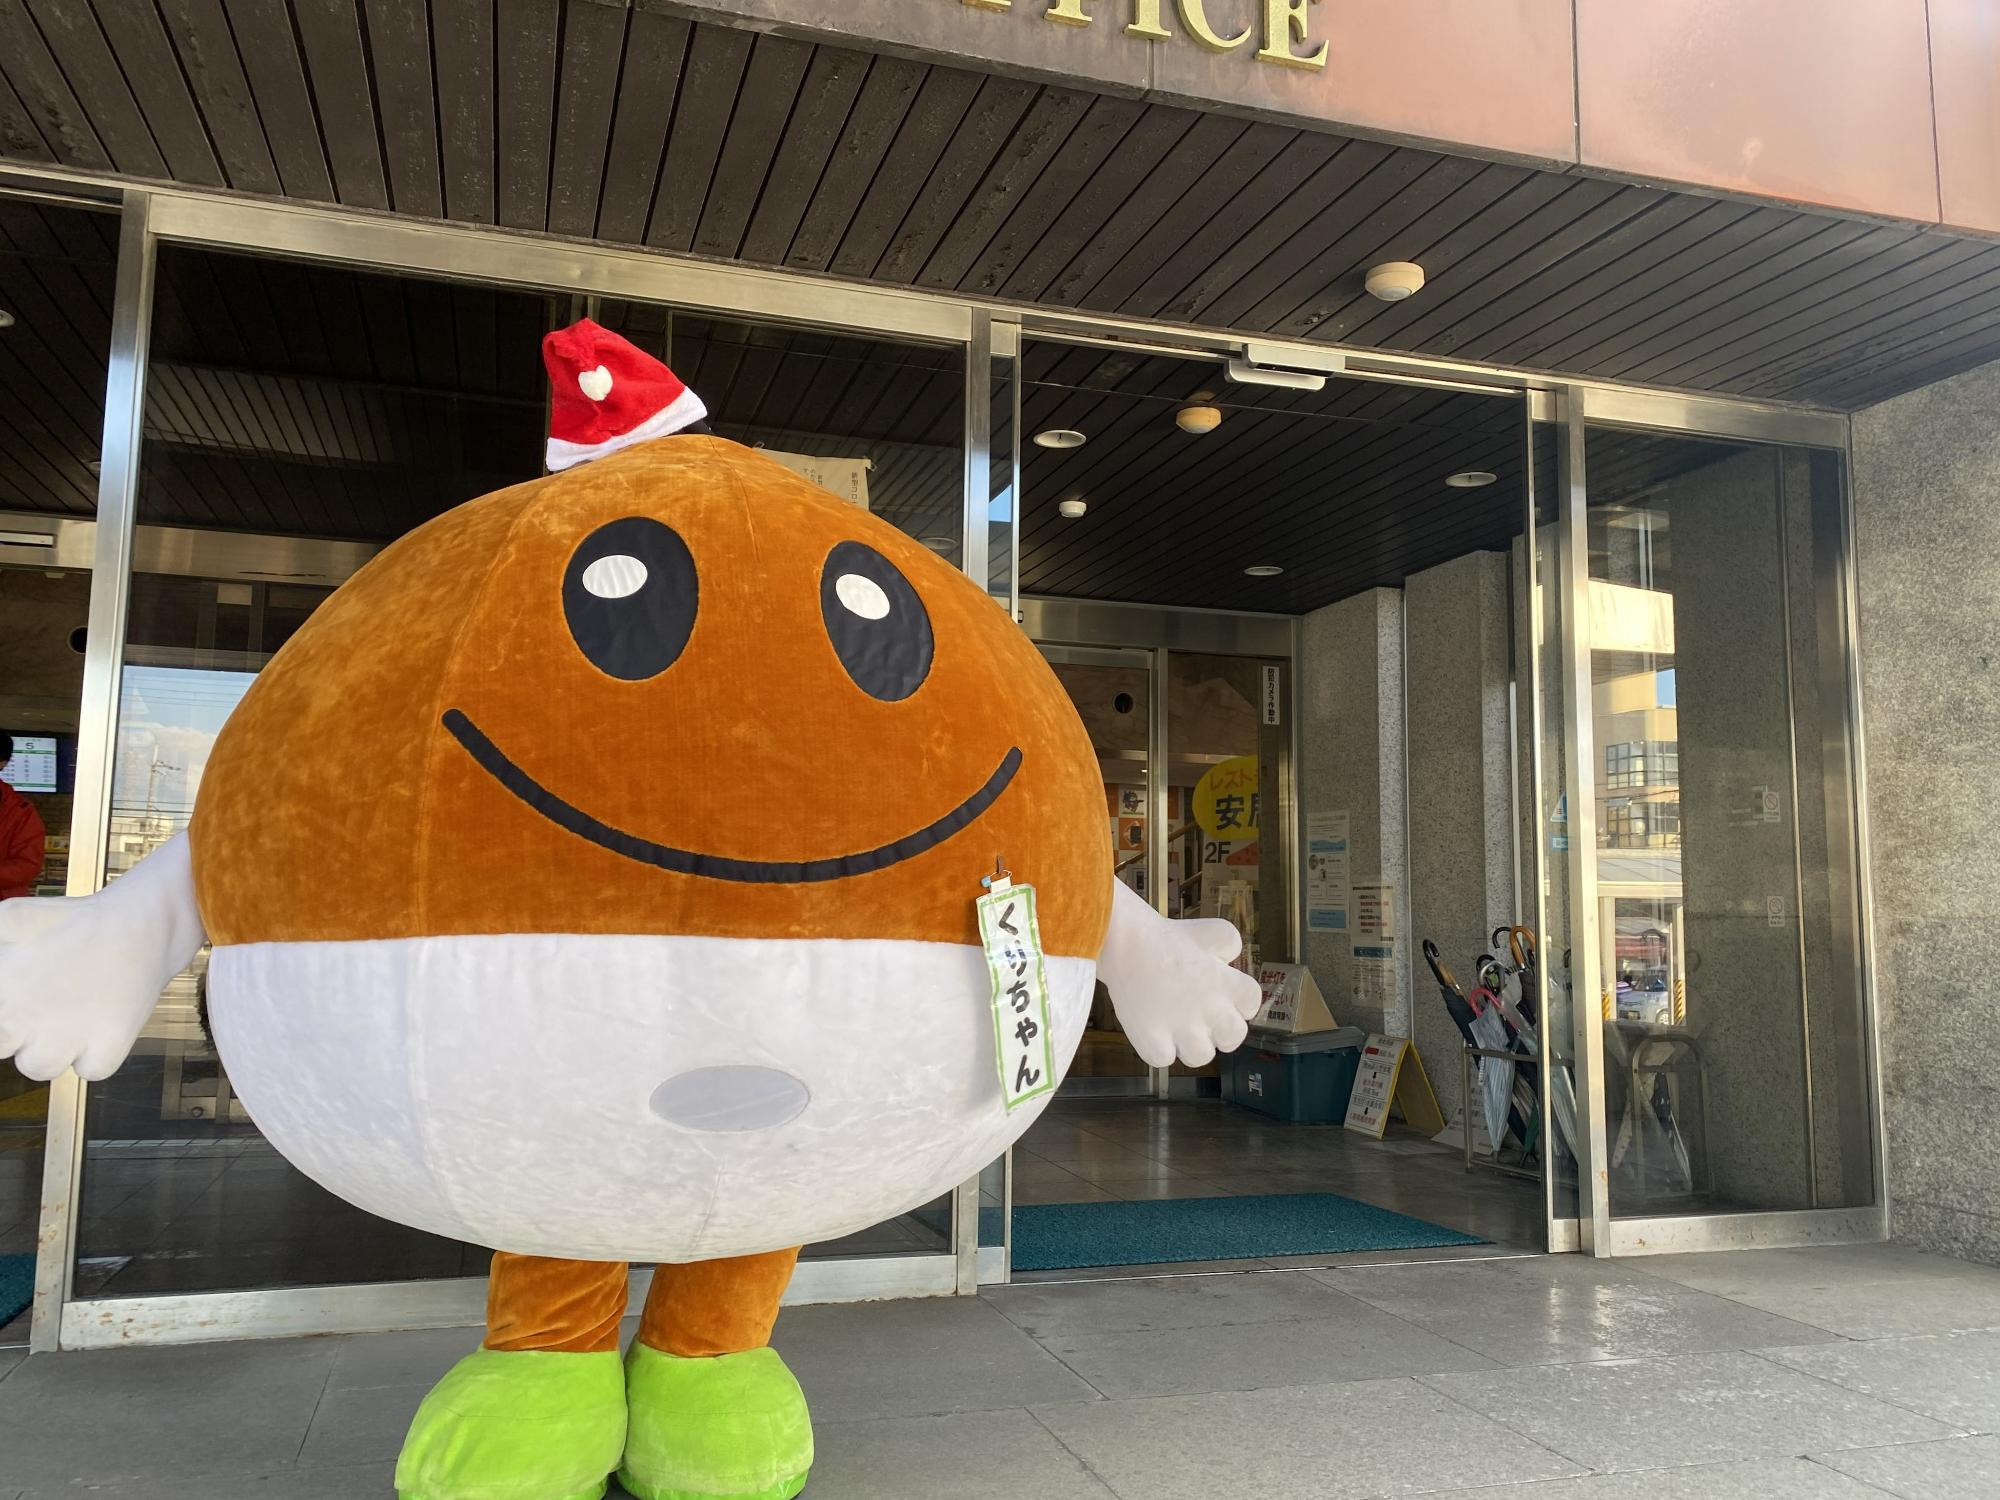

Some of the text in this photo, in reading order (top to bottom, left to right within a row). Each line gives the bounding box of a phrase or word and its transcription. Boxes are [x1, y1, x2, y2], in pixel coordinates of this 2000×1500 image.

[1267, 668, 1275, 723] 防犯カメラ作動中
[1210, 767, 1258, 791] レスト
[1204, 841, 1231, 864] 2F
[998, 902, 1040, 1093] くりちゃん
